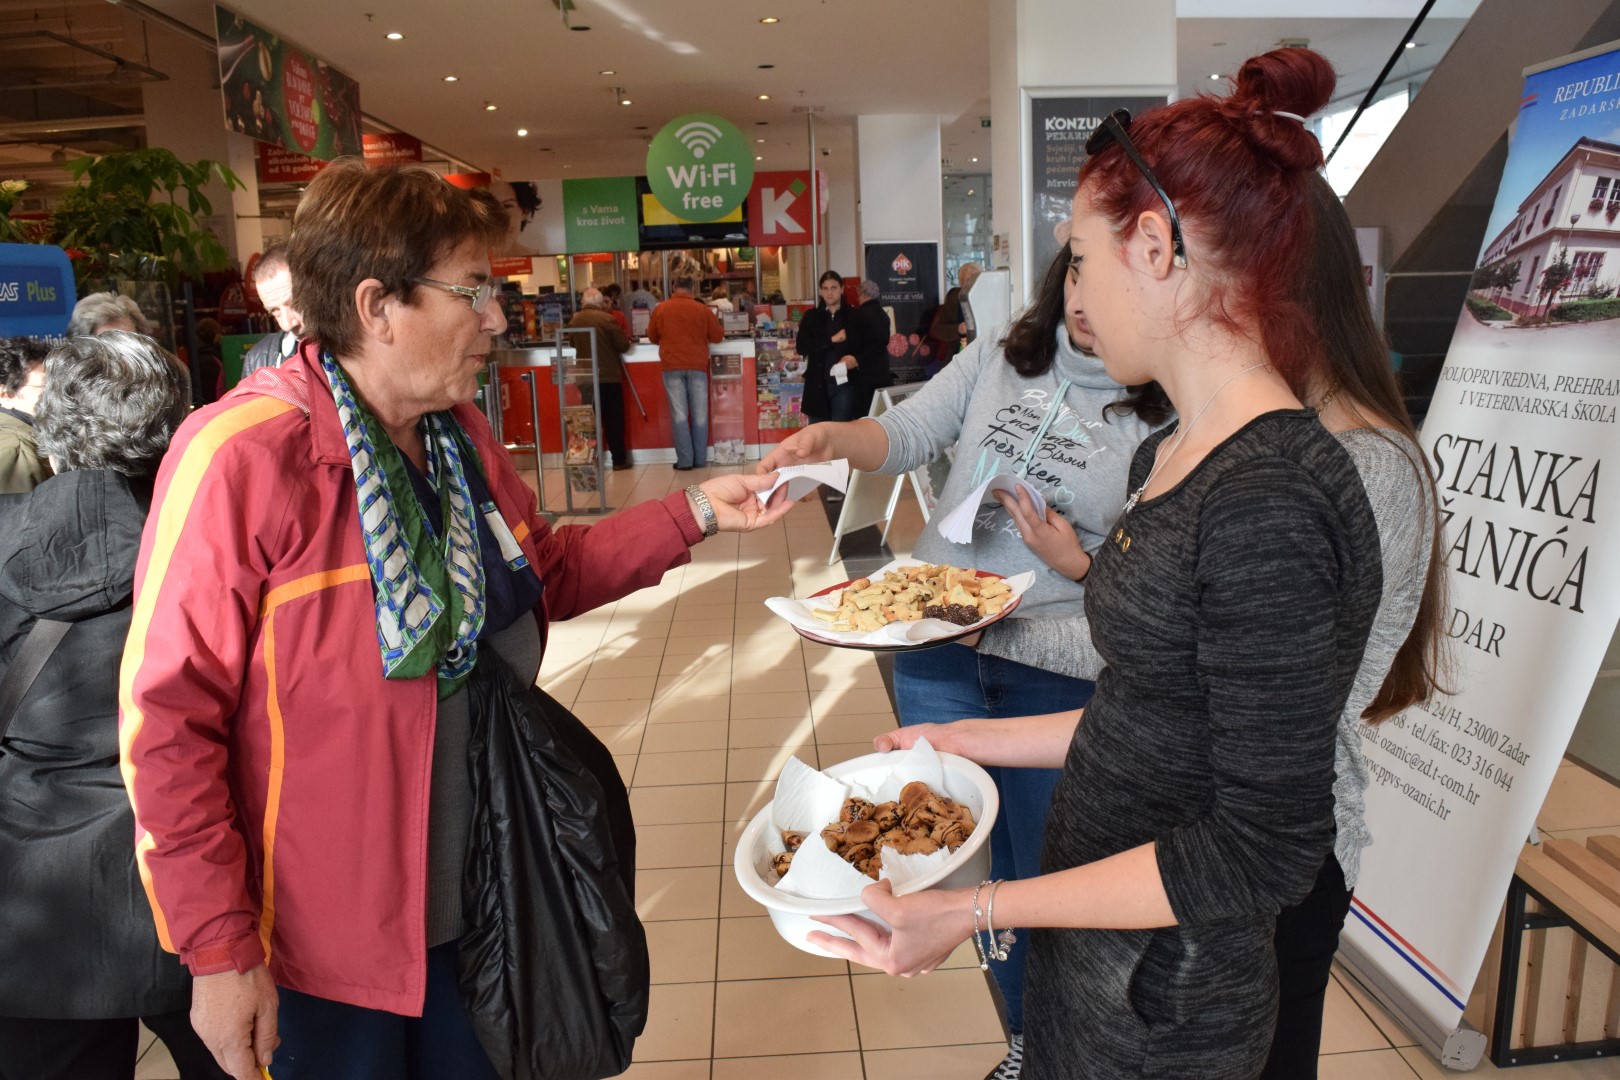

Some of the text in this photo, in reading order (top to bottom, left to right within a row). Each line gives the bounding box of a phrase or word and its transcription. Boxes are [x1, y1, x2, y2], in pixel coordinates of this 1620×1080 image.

[1045, 131, 1091, 141] PEKARN
[590, 204, 619, 214] Vama
[682, 191, 723, 210] free
[576, 215, 626, 227] kroz život
[26, 280, 56, 301] Plus
[1459, 390, 1616, 423] I VETERINARSKA ŠKOLA
[978, 424, 1024, 458] Très
[1036, 443, 1087, 469] Bisous
[1433, 433, 1601, 524] STANKA
[1439, 495, 1589, 613] ŽANIĆA
[1446, 607, 1506, 657] DAR
[1428, 701, 1461, 732] 24/H,
[1463, 717, 1499, 748] 23000
[1498, 734, 1531, 767] Zadar
[1355, 723, 1481, 806] -mail: ozanic@zd.t-com.hr
[1389, 713, 1514, 793] 68 tel./fax: 023 316 044
